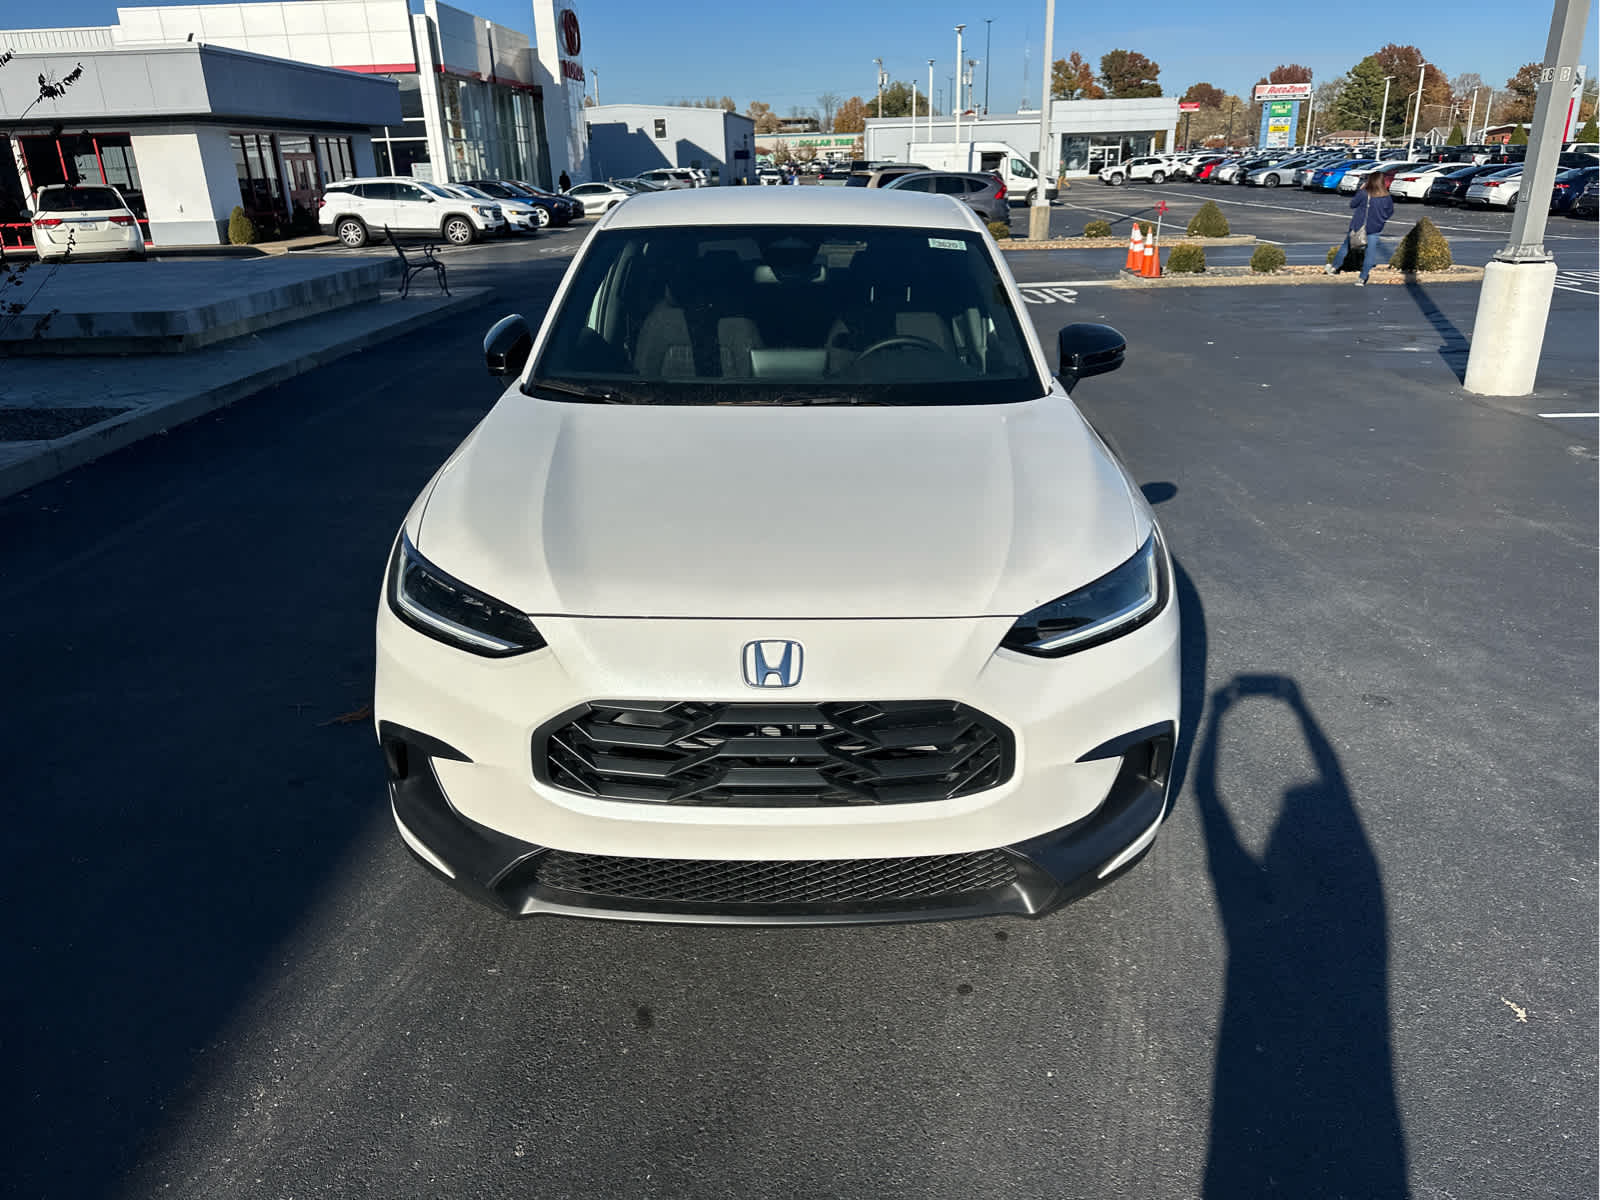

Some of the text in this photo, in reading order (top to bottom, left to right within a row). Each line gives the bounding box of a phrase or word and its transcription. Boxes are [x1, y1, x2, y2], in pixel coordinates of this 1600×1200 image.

[1267, 85, 1307, 95] AutoZone
[799, 138, 855, 147] DOLLAR TREE
